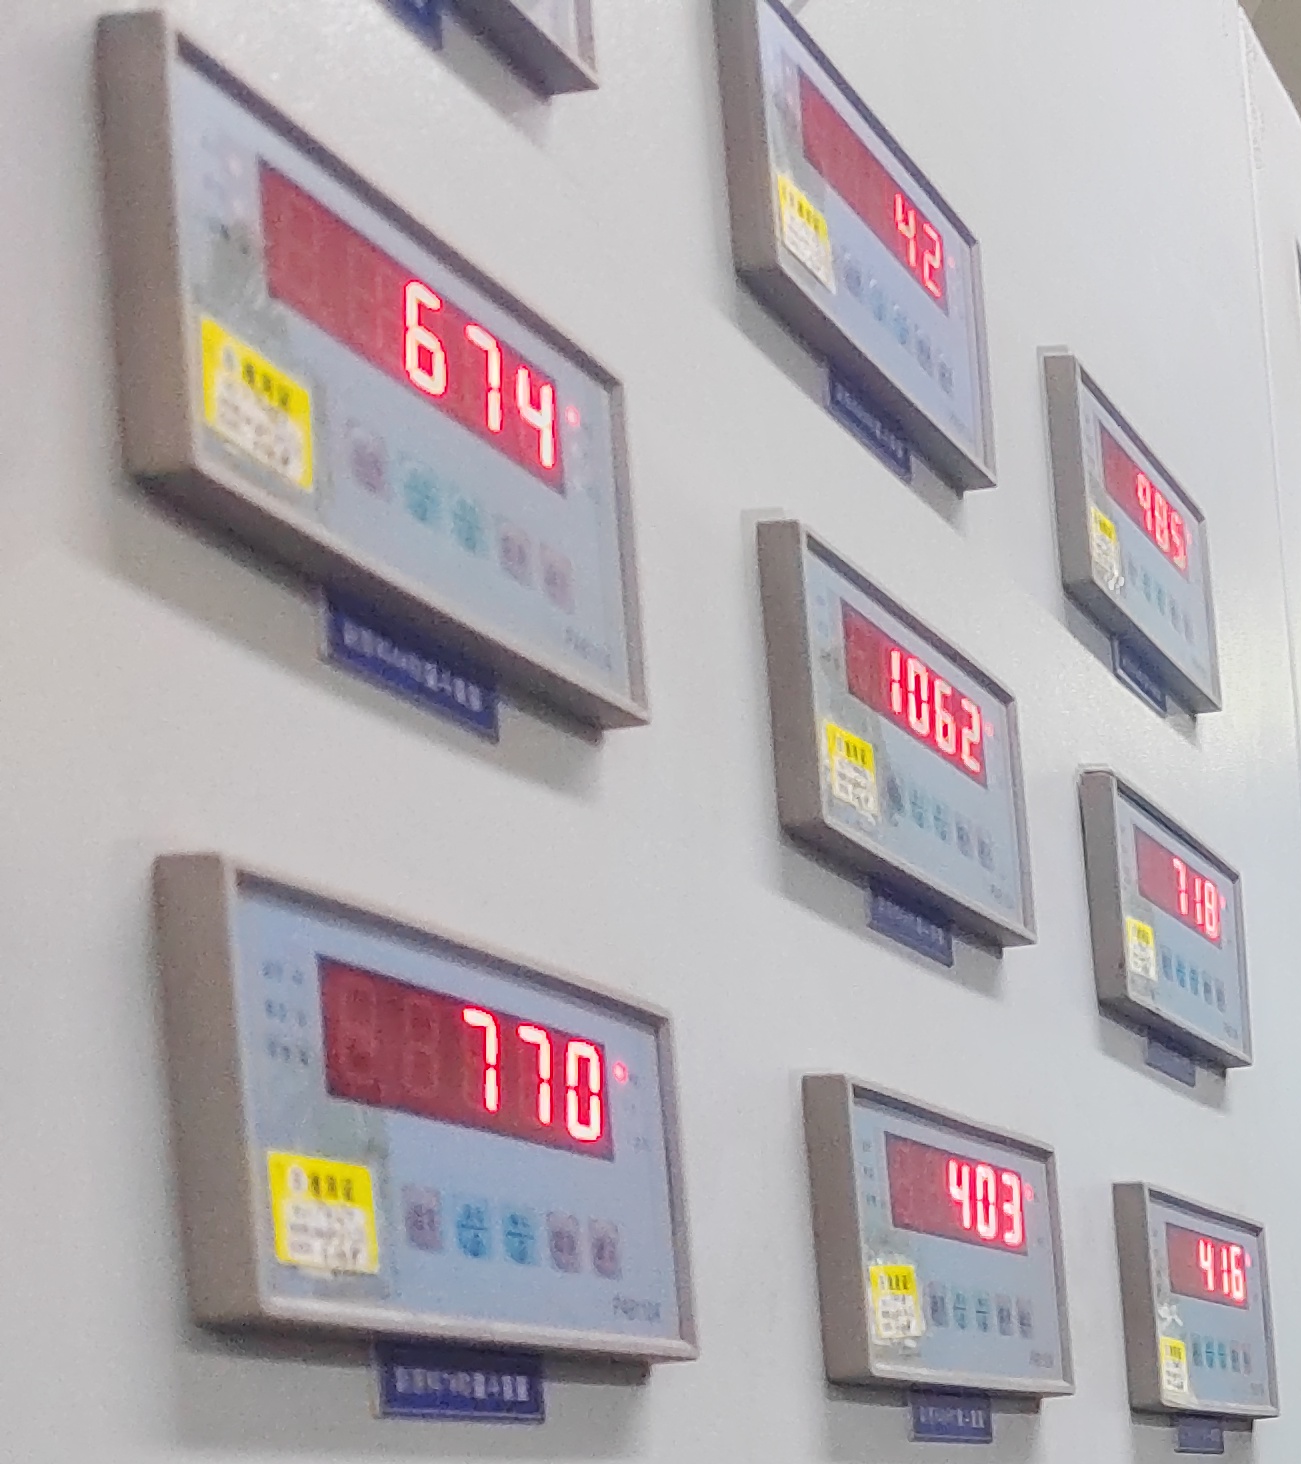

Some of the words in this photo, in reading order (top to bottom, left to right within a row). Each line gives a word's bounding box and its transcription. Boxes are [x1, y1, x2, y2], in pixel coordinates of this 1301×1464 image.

[894, 193, 943, 298] 42
[404, 279, 556, 469] 674
[890, 650, 982, 773] 1062
[1173, 857, 1219, 939] 718
[463, 1006, 605, 1141] 770
[948, 1159, 1022, 1247] 403
[1198, 1238, 1245, 1303] 416
